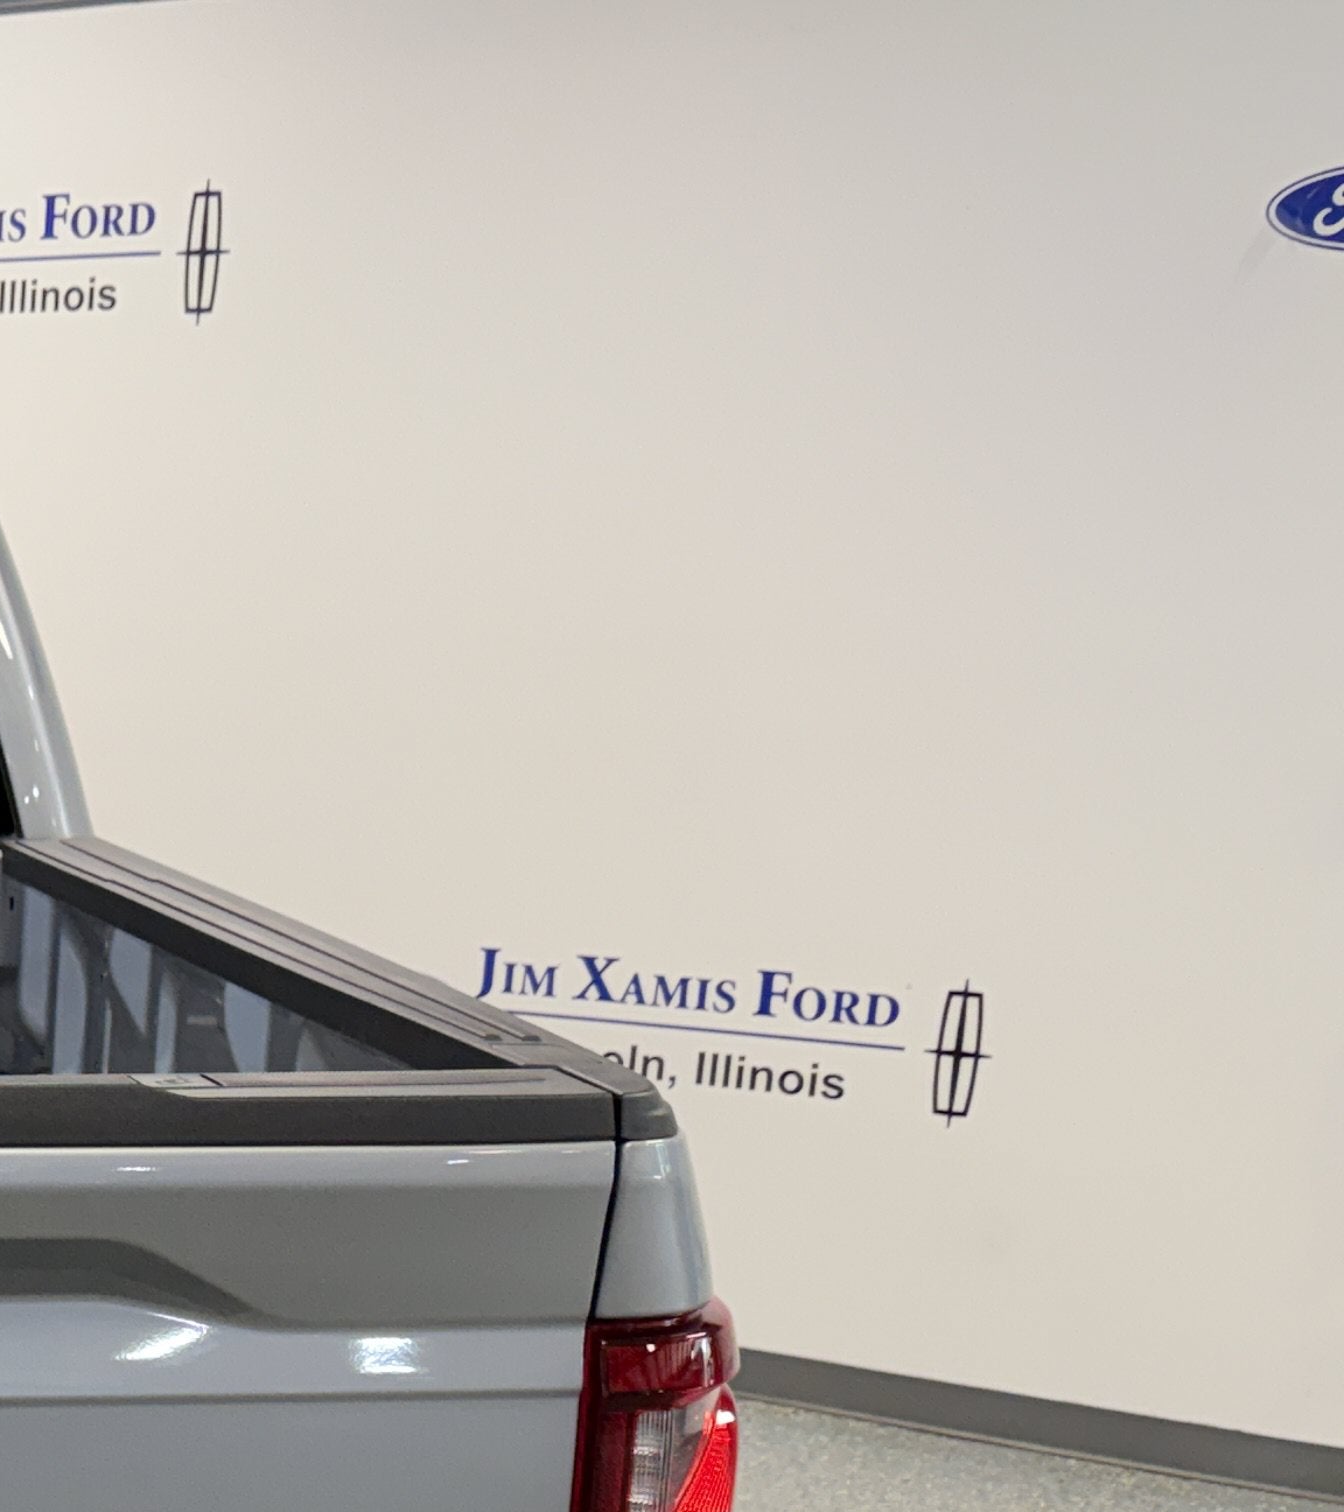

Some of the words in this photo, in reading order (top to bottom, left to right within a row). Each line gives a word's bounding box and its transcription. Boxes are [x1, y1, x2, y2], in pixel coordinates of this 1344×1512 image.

[41, 194, 156, 240] FORD
[0, 276, 117, 313] Illinois
[476, 948, 557, 999] JIM
[576, 955, 737, 1013] XAMIS
[754, 970, 900, 1028] FORD
[695, 1051, 845, 1100] Illinois
